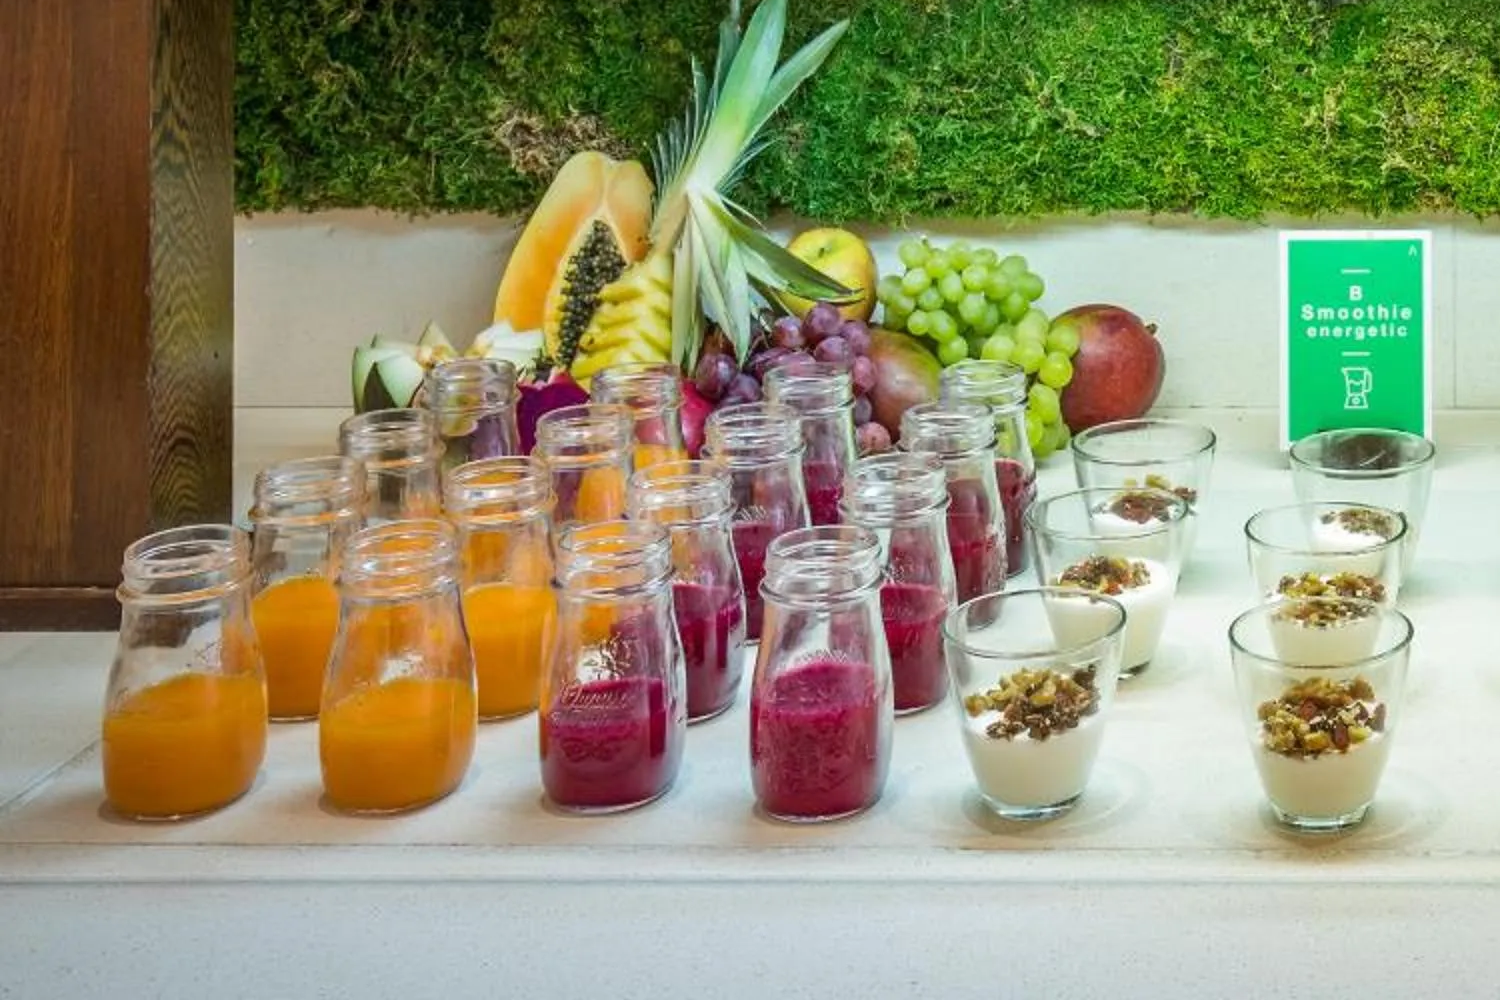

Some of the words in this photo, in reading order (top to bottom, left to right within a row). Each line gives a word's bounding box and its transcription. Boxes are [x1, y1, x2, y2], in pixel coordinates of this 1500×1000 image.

[1349, 285, 1363, 301] B
[1300, 303, 1413, 321] Smoothie
[1306, 322, 1409, 341] energetic
